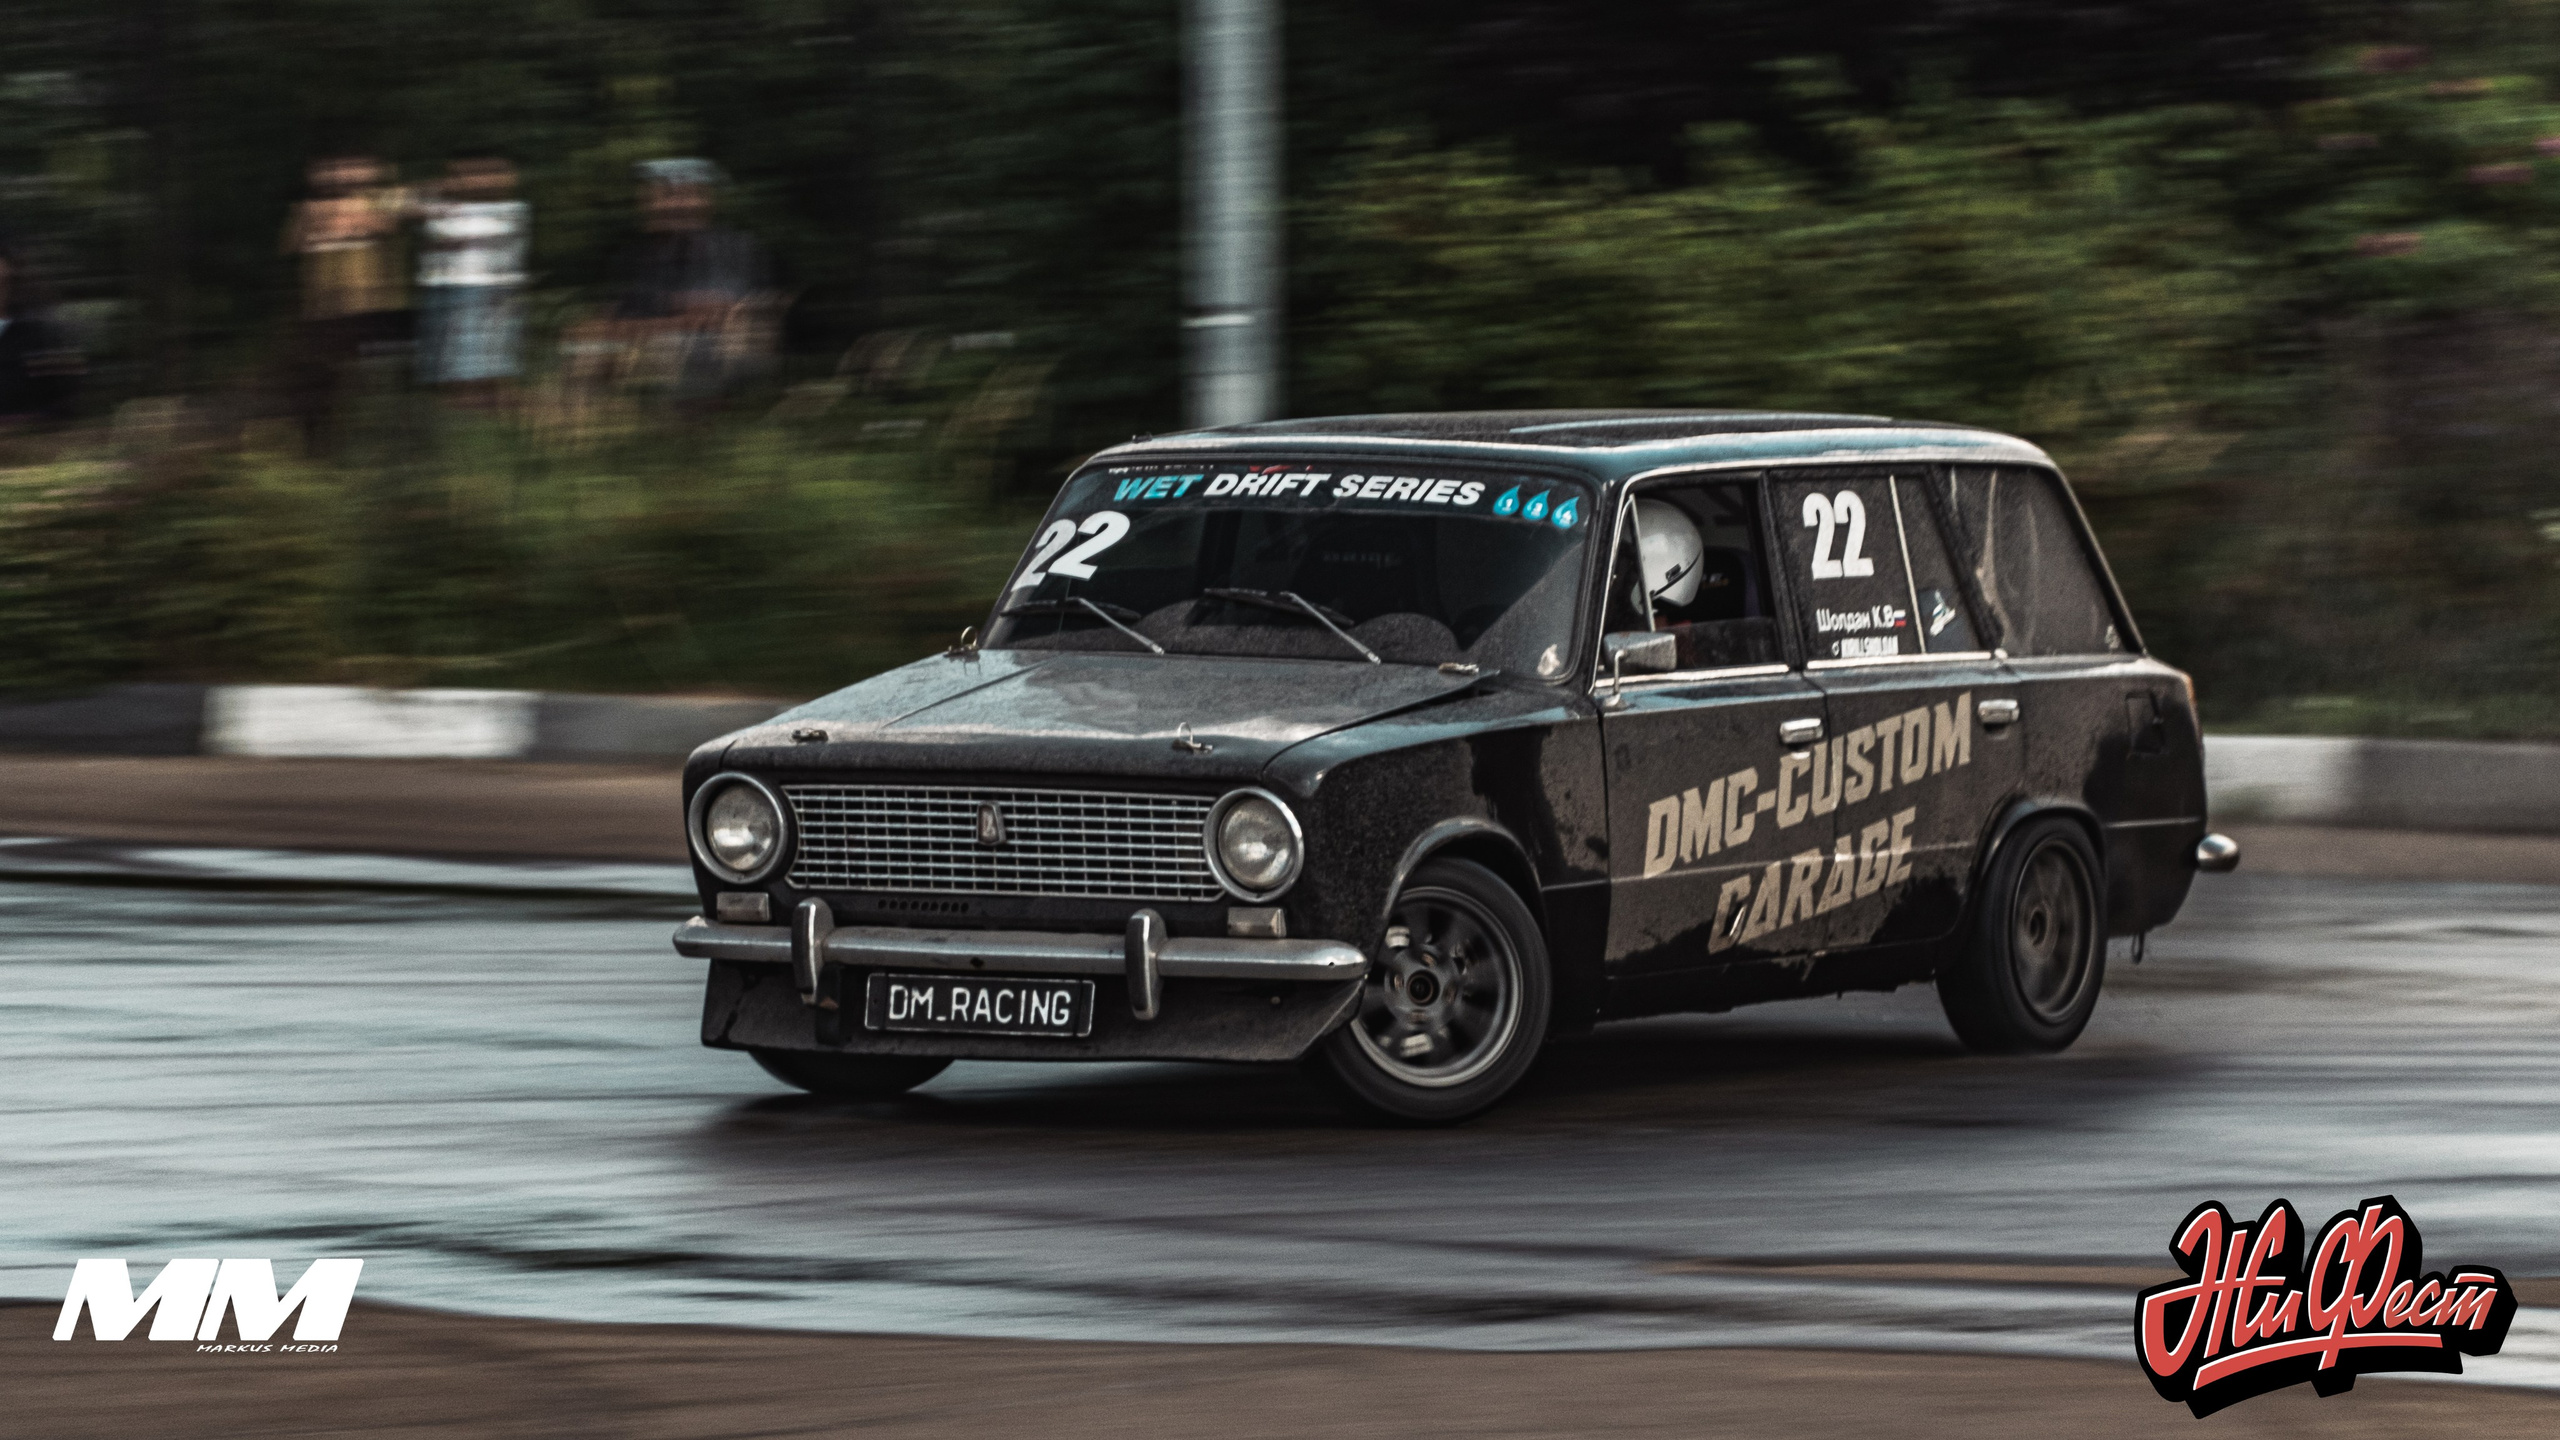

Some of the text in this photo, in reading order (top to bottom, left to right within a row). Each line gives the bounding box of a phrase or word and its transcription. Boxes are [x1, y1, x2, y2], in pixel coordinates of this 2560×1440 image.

[1113, 472, 1486, 506] WET DRIFT SERIES
[1011, 510, 1131, 593] 22
[1802, 489, 1875, 581] 22
[1643, 690, 1972, 881] DMC-CUSTOM
[1707, 806, 1917, 954] GARAGE
[888, 984, 1072, 1026] DM_RACING
